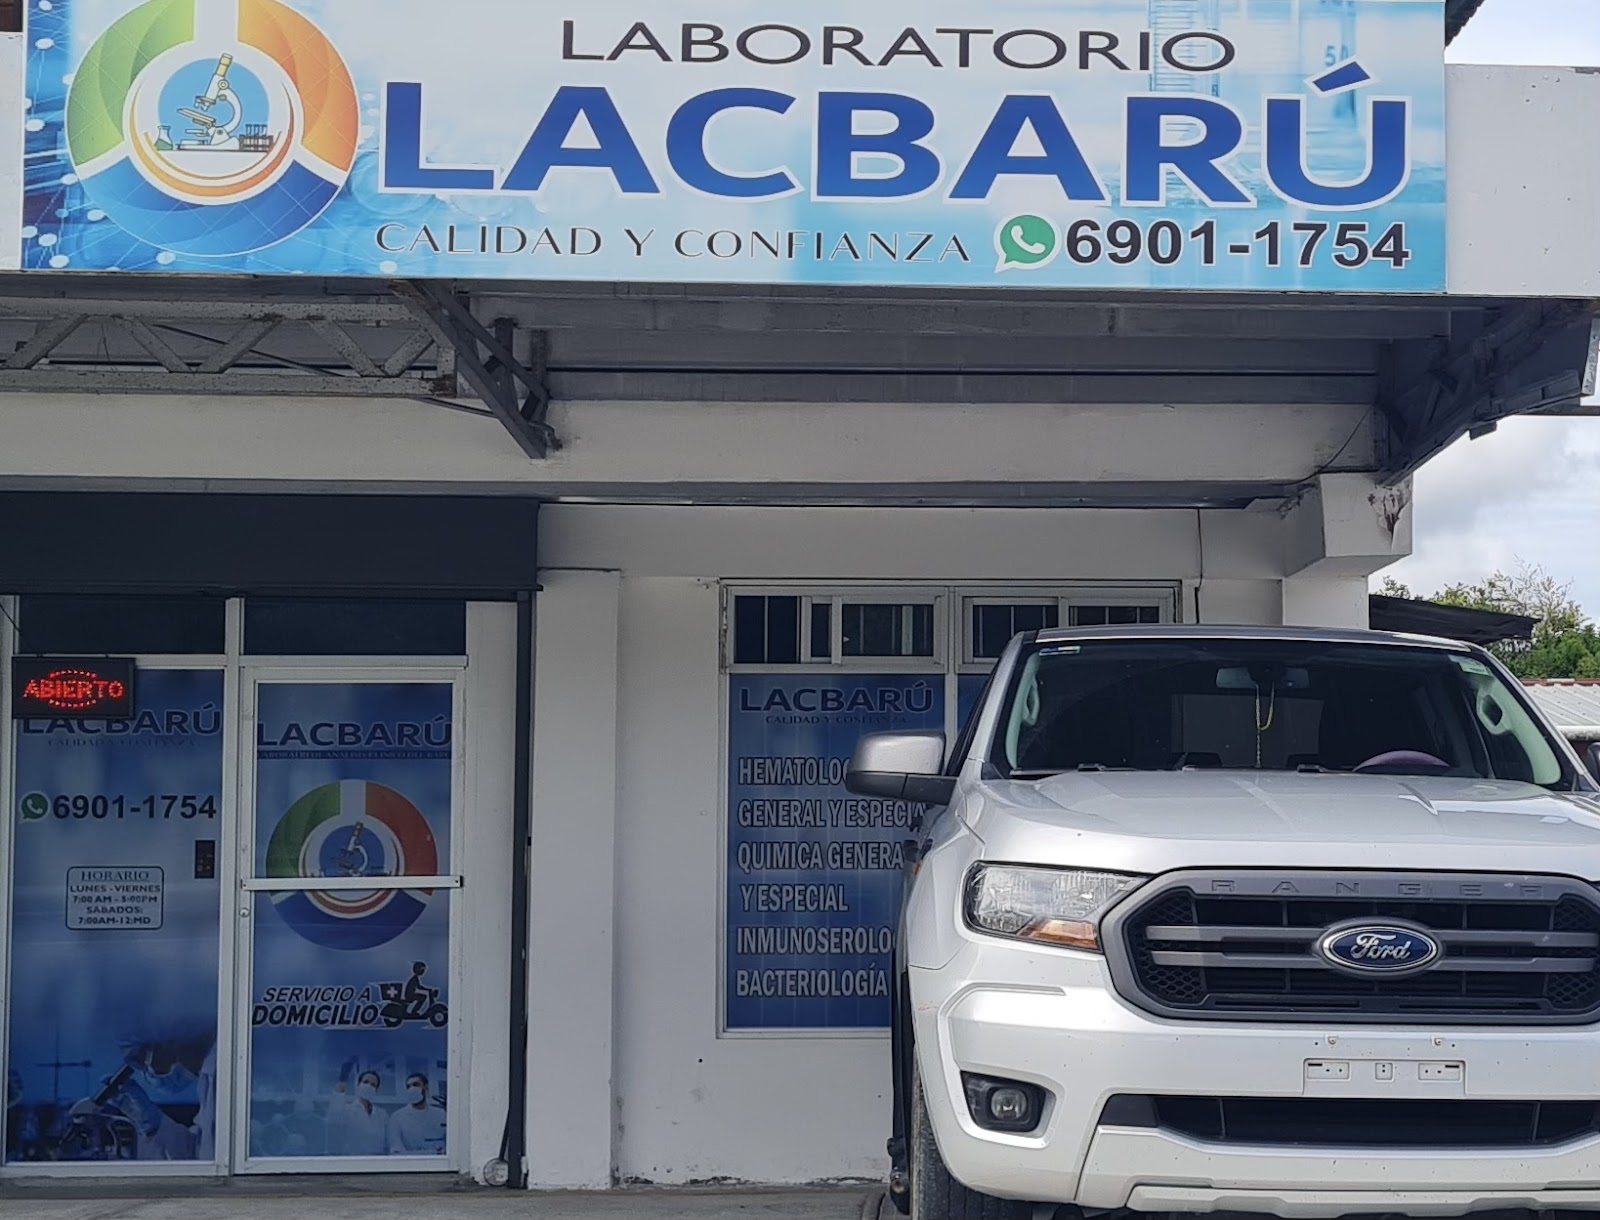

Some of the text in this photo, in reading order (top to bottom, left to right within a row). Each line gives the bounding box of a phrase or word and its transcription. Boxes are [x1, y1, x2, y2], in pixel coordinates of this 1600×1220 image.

[562, 19, 1235, 72] LABORATORIO
[384, 60, 1408, 206] LACBARÚ
[376, 222, 970, 262] CALIDAD Y CONFIANZA
[1067, 218, 1411, 268] 6901-1754
[23, 679, 125, 699] ABIERTO
[741, 680, 933, 713] LACBARÚ
[22, 702, 221, 735] LACBARÚ
[257, 714, 451, 747] LACBARÚ
[53, 794, 217, 819] 6901-1754
[738, 799, 927, 828] GENERAL Y ESPECIA
[737, 841, 824, 874] QUIMICA
[70, 885, 107, 893] LUNES
[114, 884, 161, 893] VIERNES
[82, 871, 149, 881] HORARIO
[1211, 879, 1543, 898] RANGER
[95, 895, 112, 903] AM
[740, 884, 849, 912] Y ESPECIAL
[737, 926, 896, 955] INMUNOSEROLO
[1350, 932, 1412, 960] Ford
[262, 986, 373, 1002] SERVICIO A
[736, 962, 889, 998] BACTERIOLOGÍA
[252, 1004, 380, 1027] DOMICILIO
